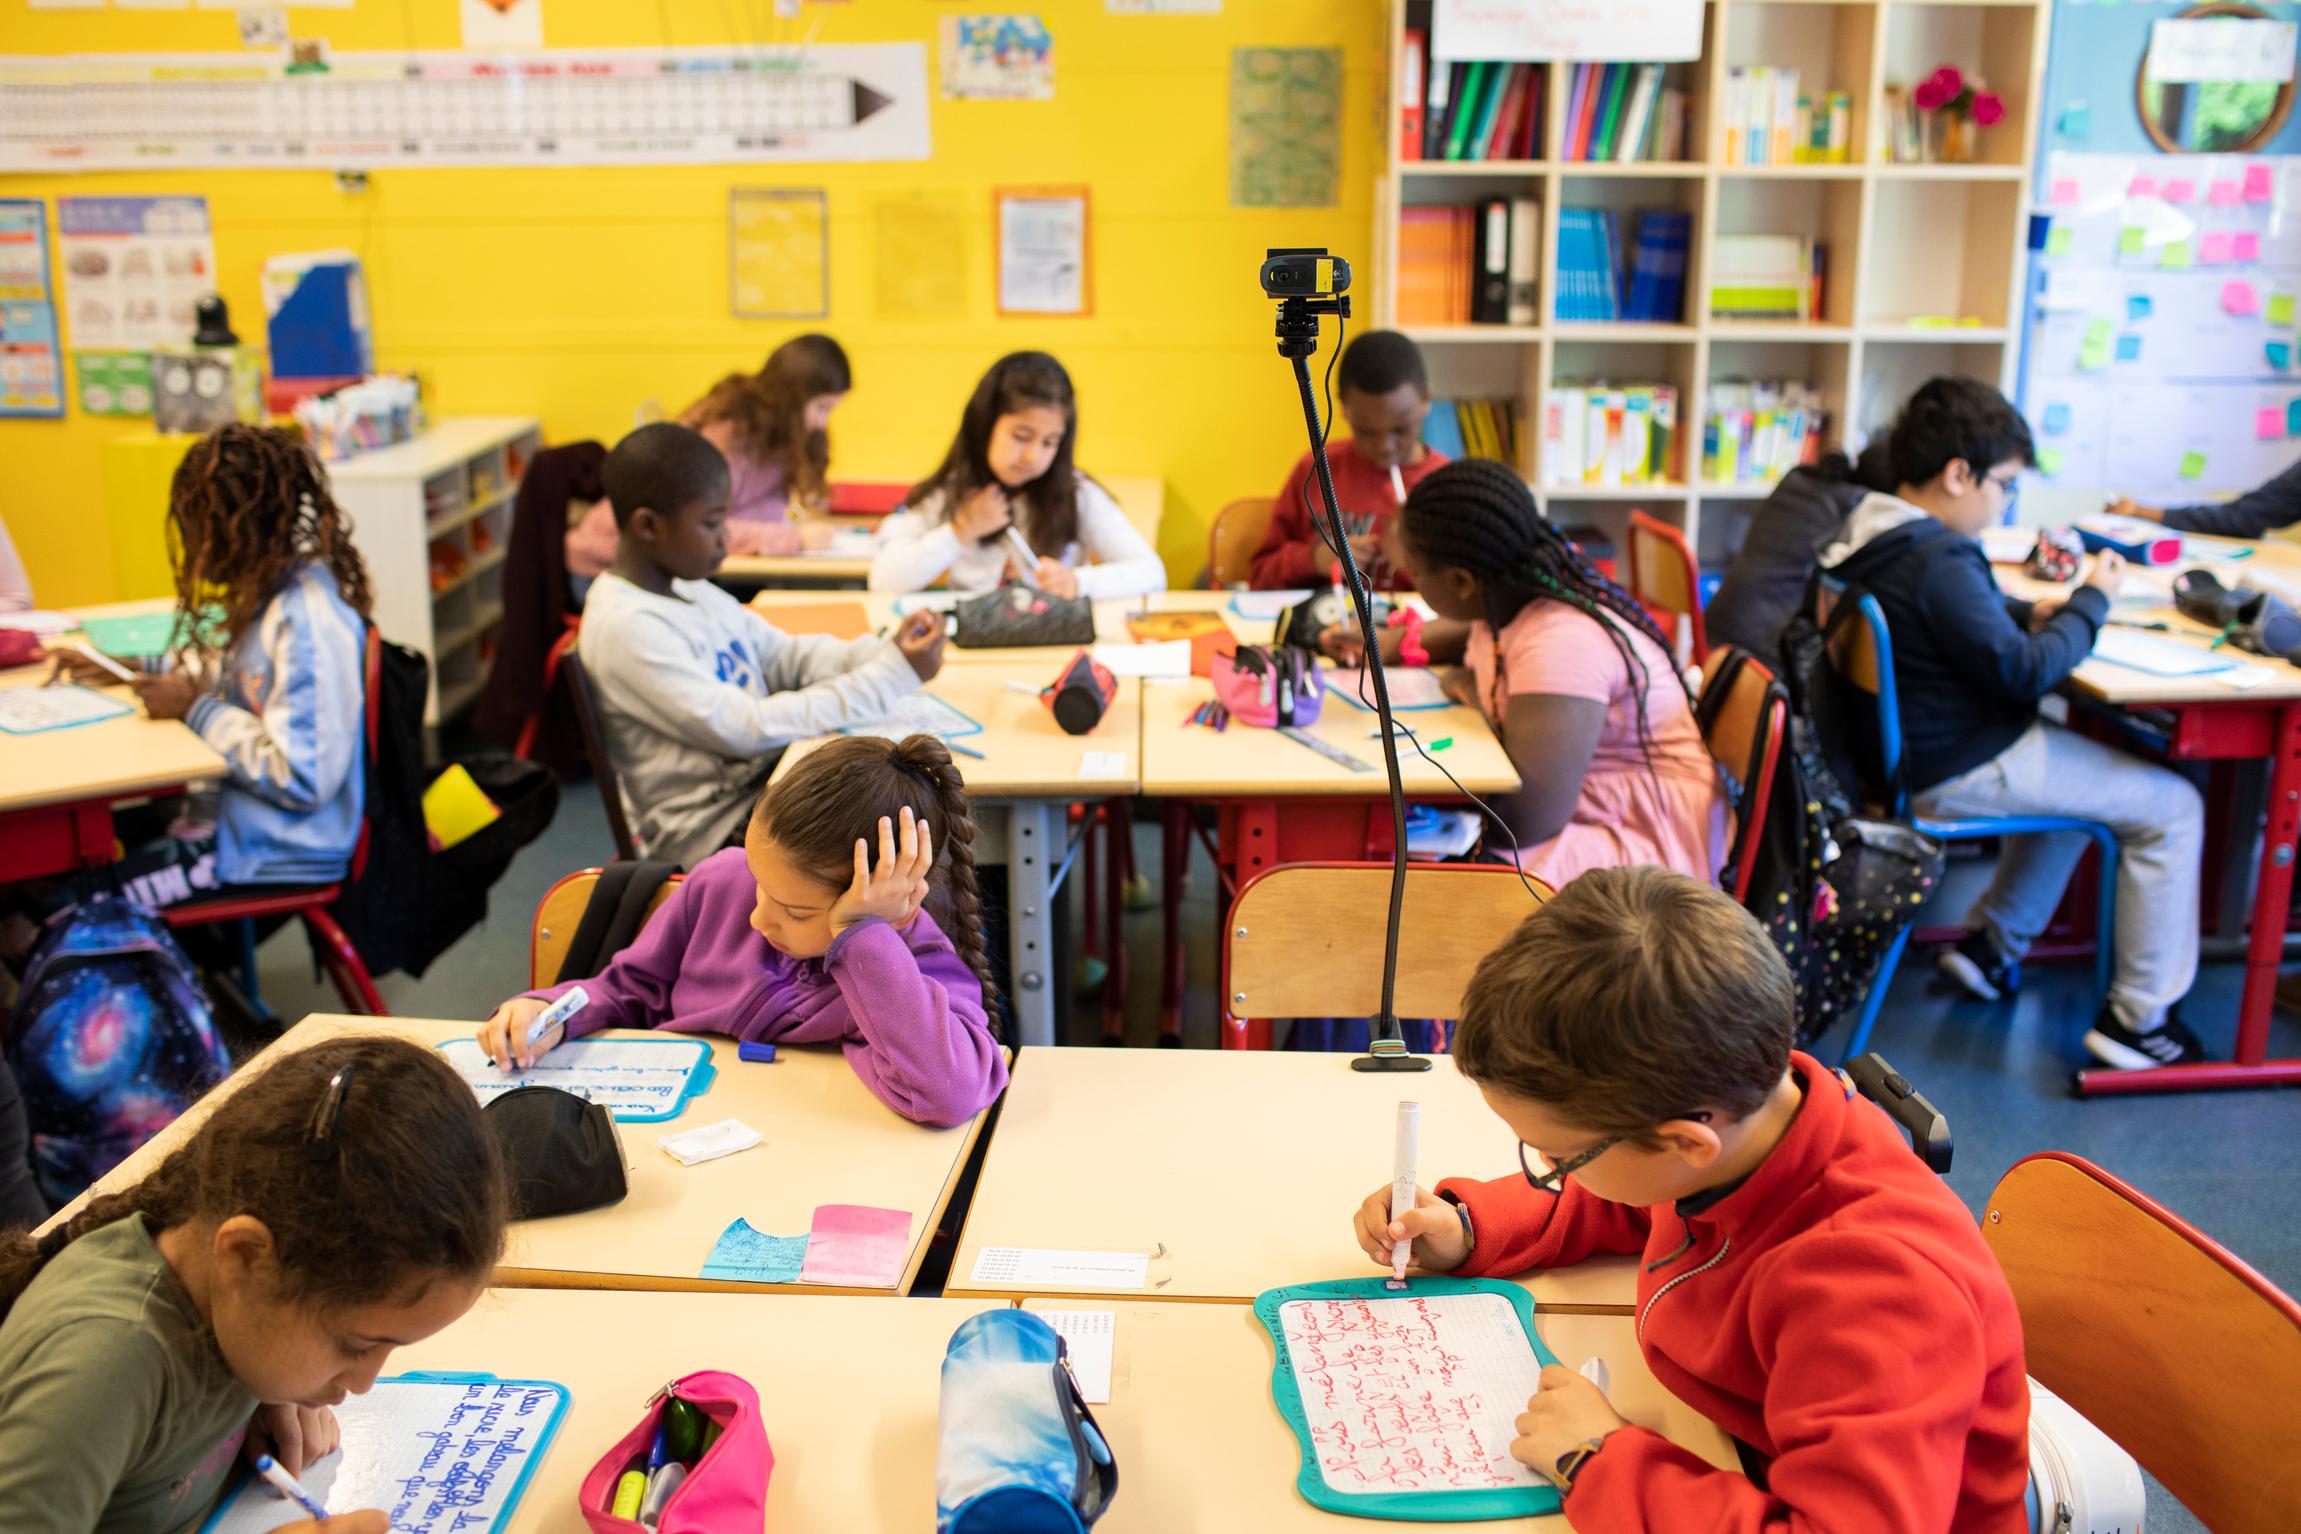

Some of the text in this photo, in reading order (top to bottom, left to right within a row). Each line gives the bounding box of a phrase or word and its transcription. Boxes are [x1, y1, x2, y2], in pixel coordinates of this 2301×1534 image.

[462, 1382, 487, 1400] un
[514, 1388, 554, 1417] Nous
[1289, 1301, 1367, 1481] Nous mélangeons
[443, 1402, 487, 1429] bon
[459, 1437, 497, 1459] les
[394, 1475, 426, 1499] que
